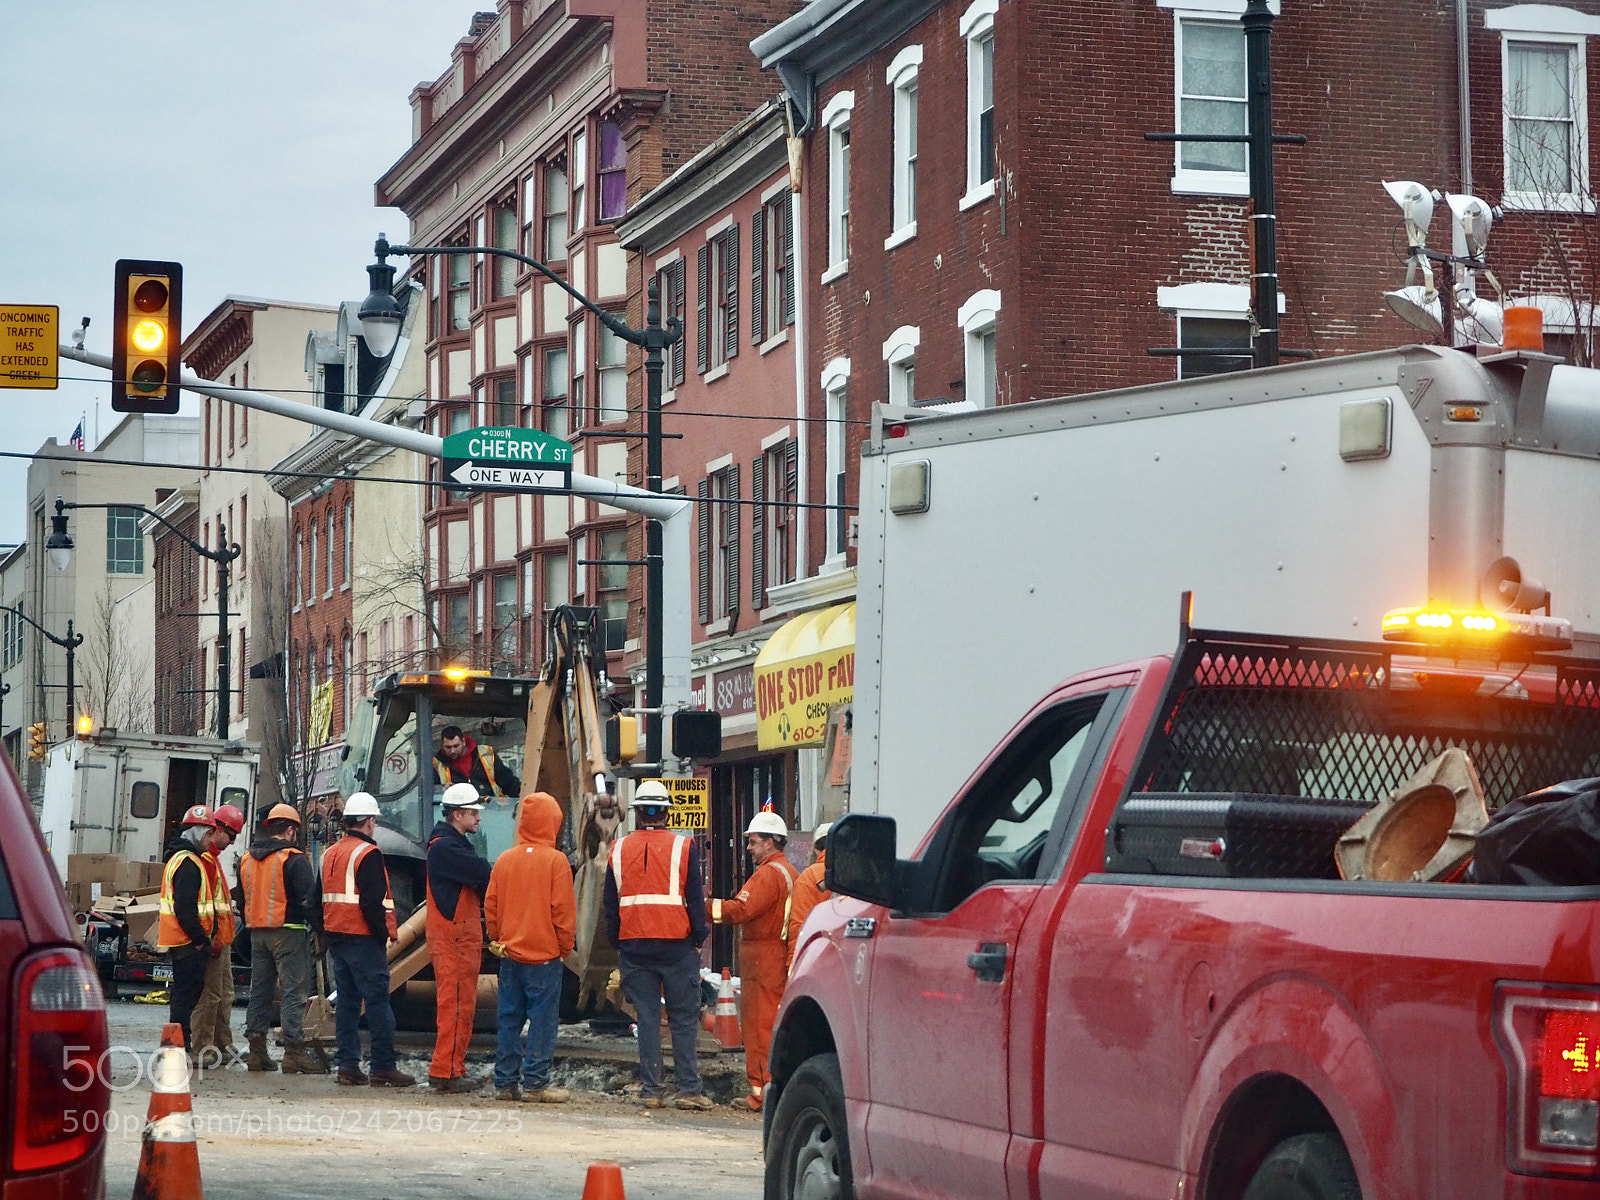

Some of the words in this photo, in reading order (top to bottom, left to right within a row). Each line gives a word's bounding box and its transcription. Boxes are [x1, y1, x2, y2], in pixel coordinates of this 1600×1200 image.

[0, 313, 50, 323] ONCOMING
[7, 327, 44, 337] TRAFFIC
[16, 342, 34, 351] HAS
[1, 356, 48, 366] EXTENDED
[9, 370, 40, 380] GREEN
[468, 438, 547, 460] CHERRY
[554, 448, 567, 461] ST
[470, 469, 502, 481] ONE
[509, 471, 544, 484] WAY
[757, 669, 784, 721] ONE
[787, 661, 823, 705] STOP
[675, 780, 706, 791] HOUSES
